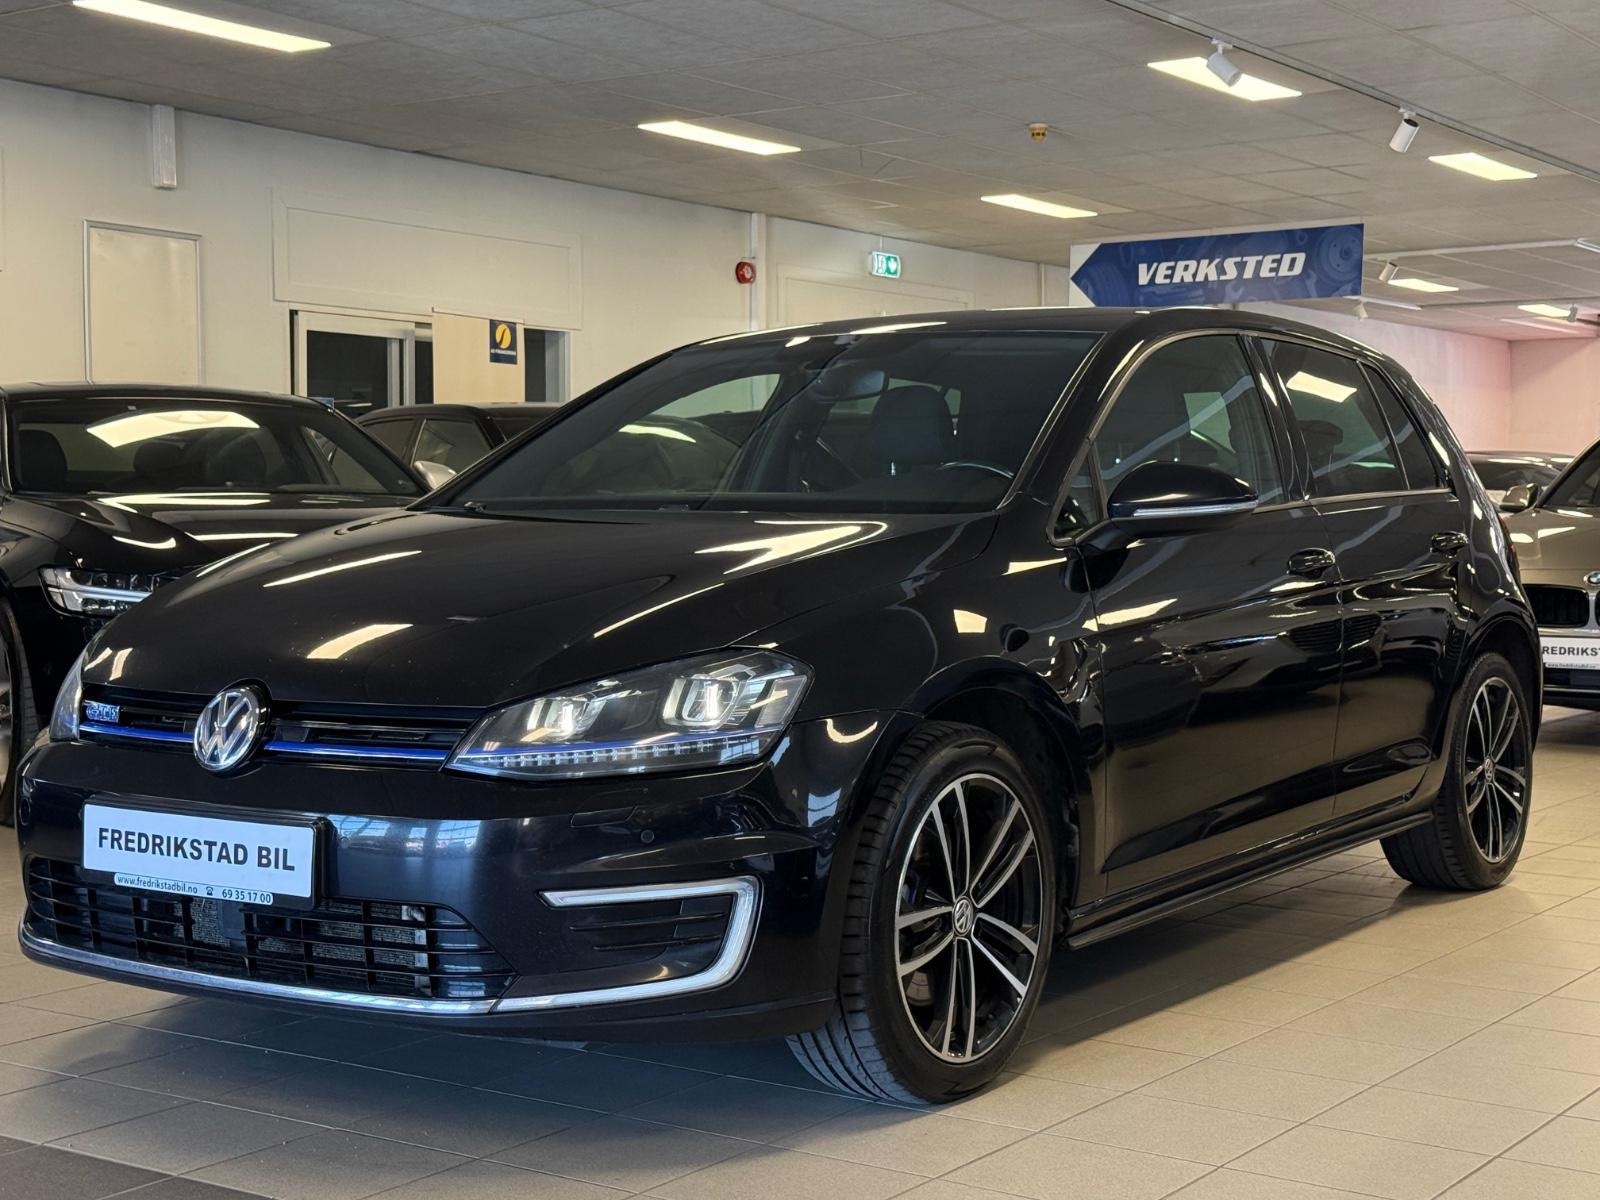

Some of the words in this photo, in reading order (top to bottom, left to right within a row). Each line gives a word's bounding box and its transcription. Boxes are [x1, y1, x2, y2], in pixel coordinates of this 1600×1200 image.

[1138, 252, 1306, 286] VERKSTED
[1542, 645, 1600, 657] REDRIKS
[98, 827, 249, 866] FREDRIKSTAD
[257, 845, 295, 871] BIL
[117, 875, 198, 894] www.fredrikstadbil.no
[222, 887, 233, 899] 69
[235, 889, 245, 900] 35
[247, 891, 258, 902] 17
[260, 892, 271, 903] 00
